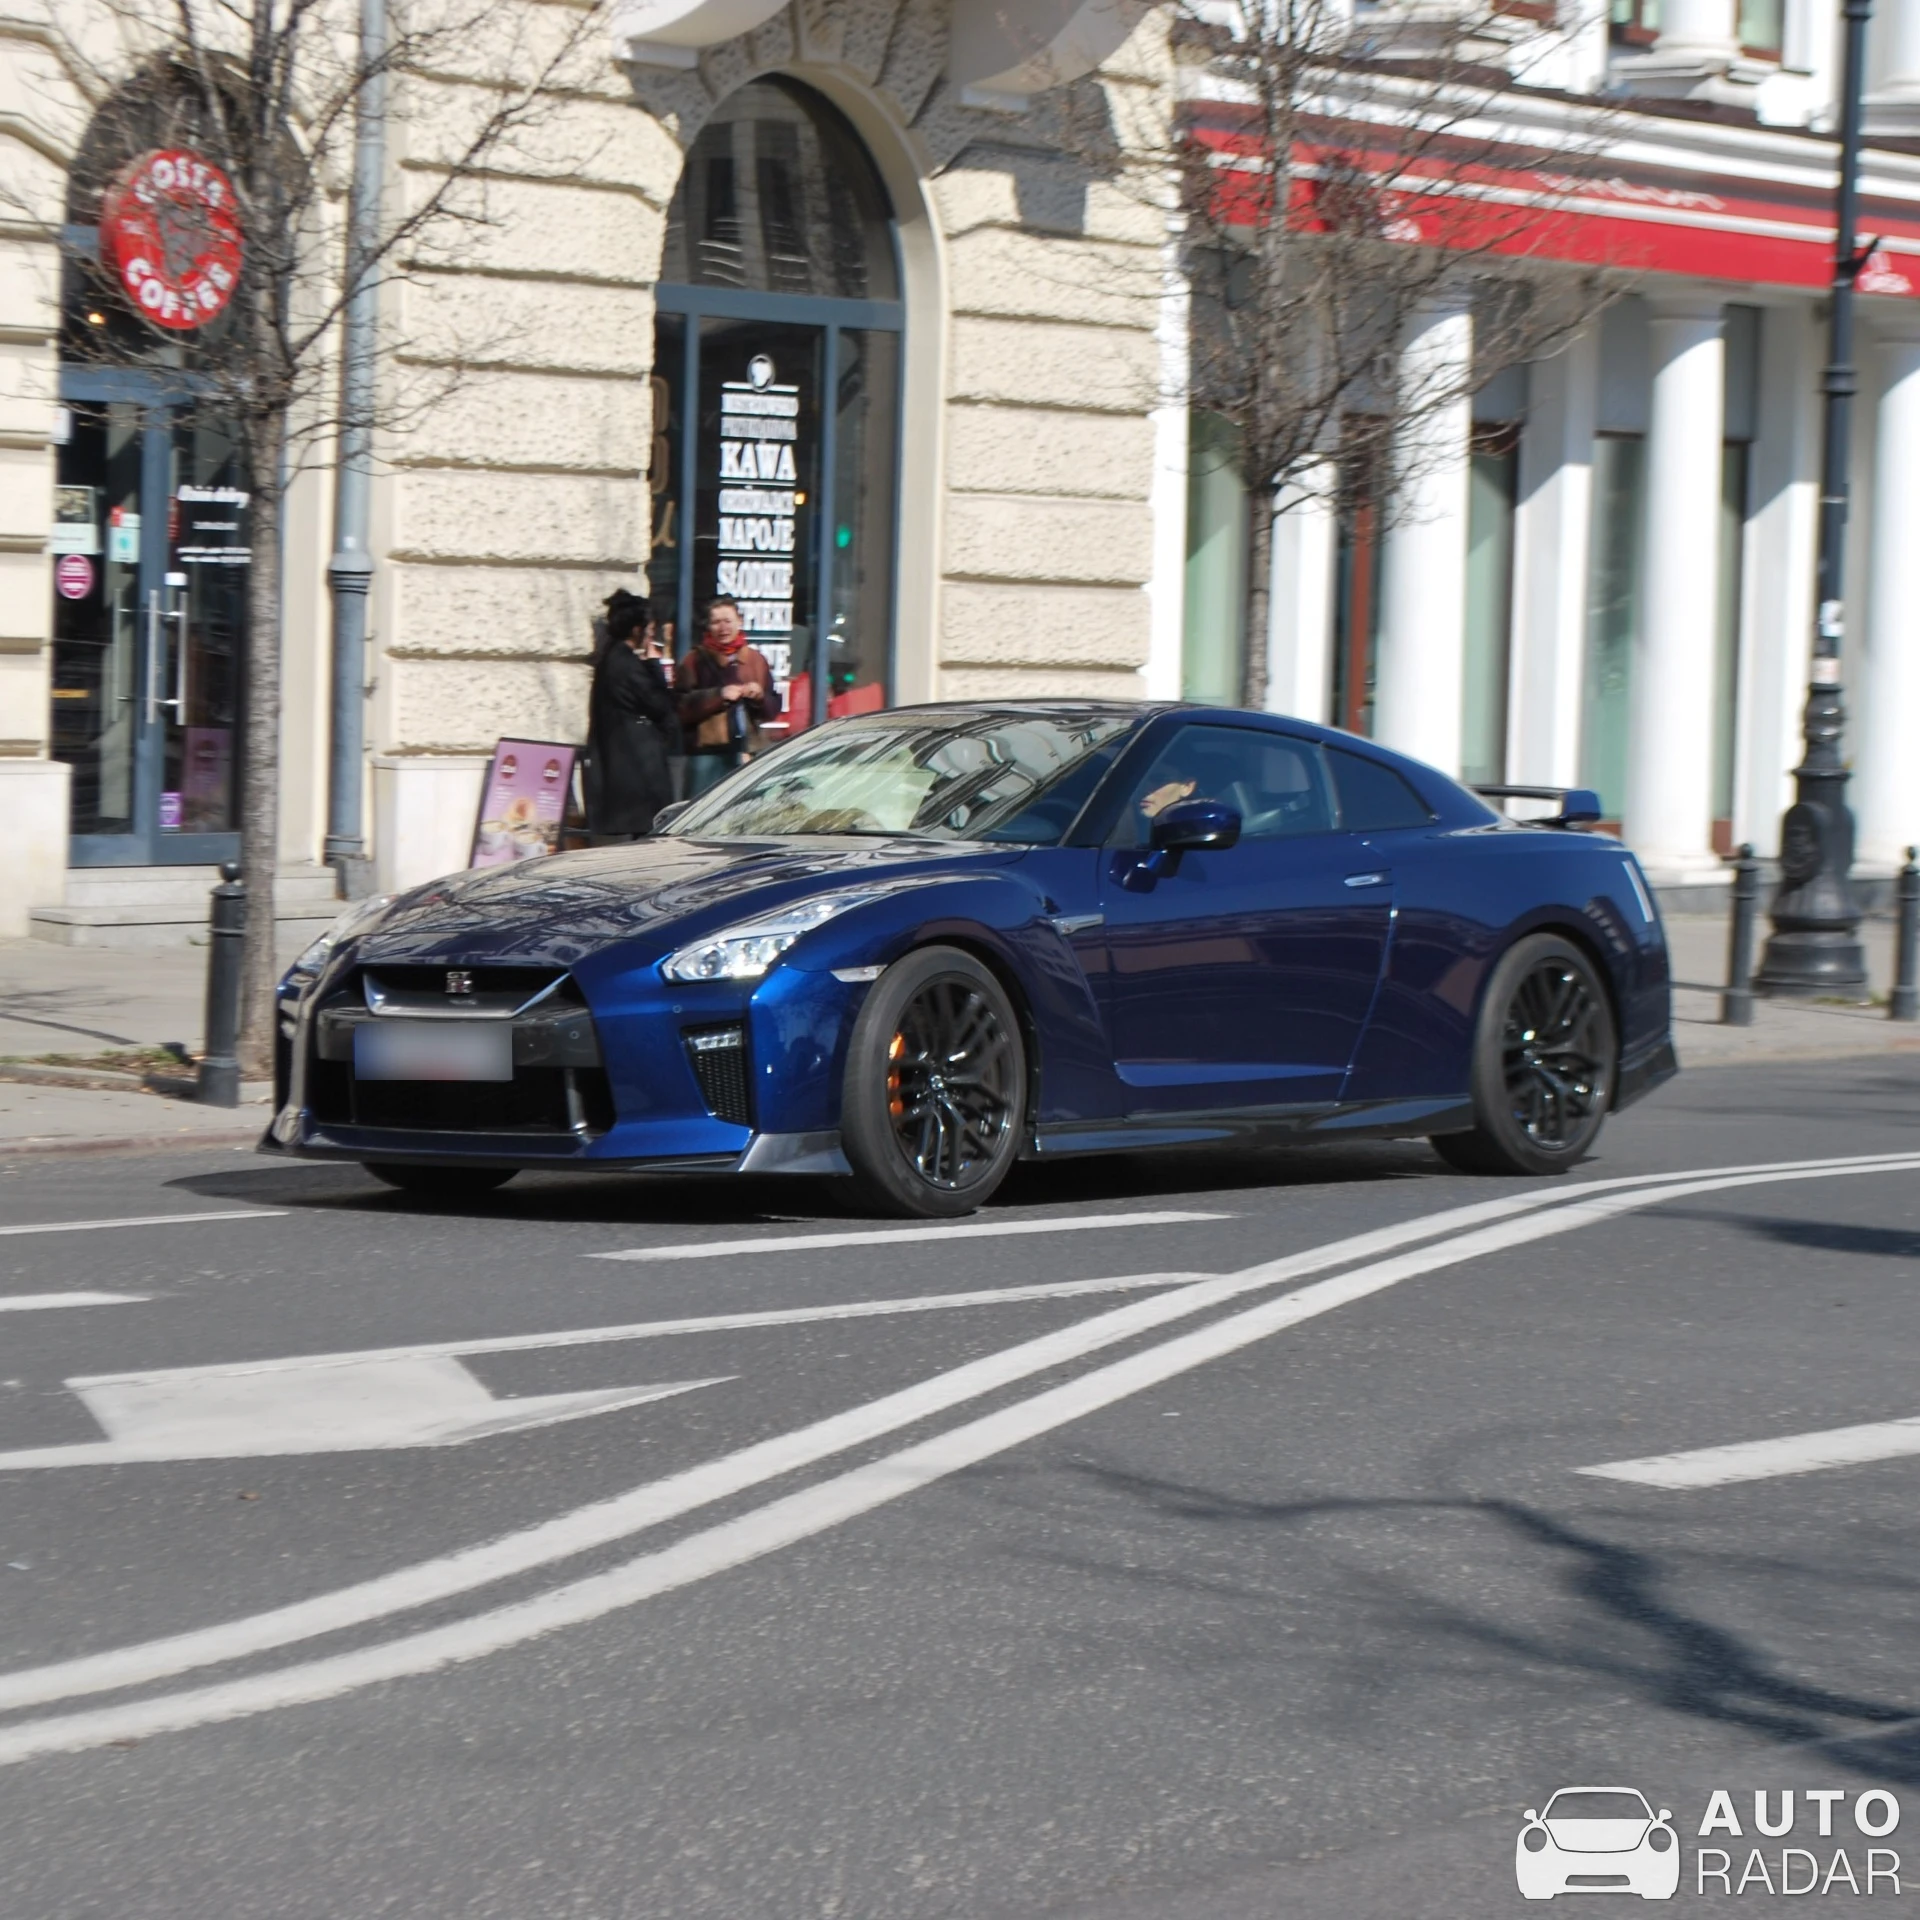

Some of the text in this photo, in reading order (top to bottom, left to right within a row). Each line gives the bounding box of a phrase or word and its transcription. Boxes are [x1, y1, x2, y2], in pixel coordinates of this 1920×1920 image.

[134, 157, 225, 207] COSTA
[127, 257, 232, 321] COFFEE
[719, 441, 797, 479] KAWA
[718, 517, 795, 551] NAPOJE
